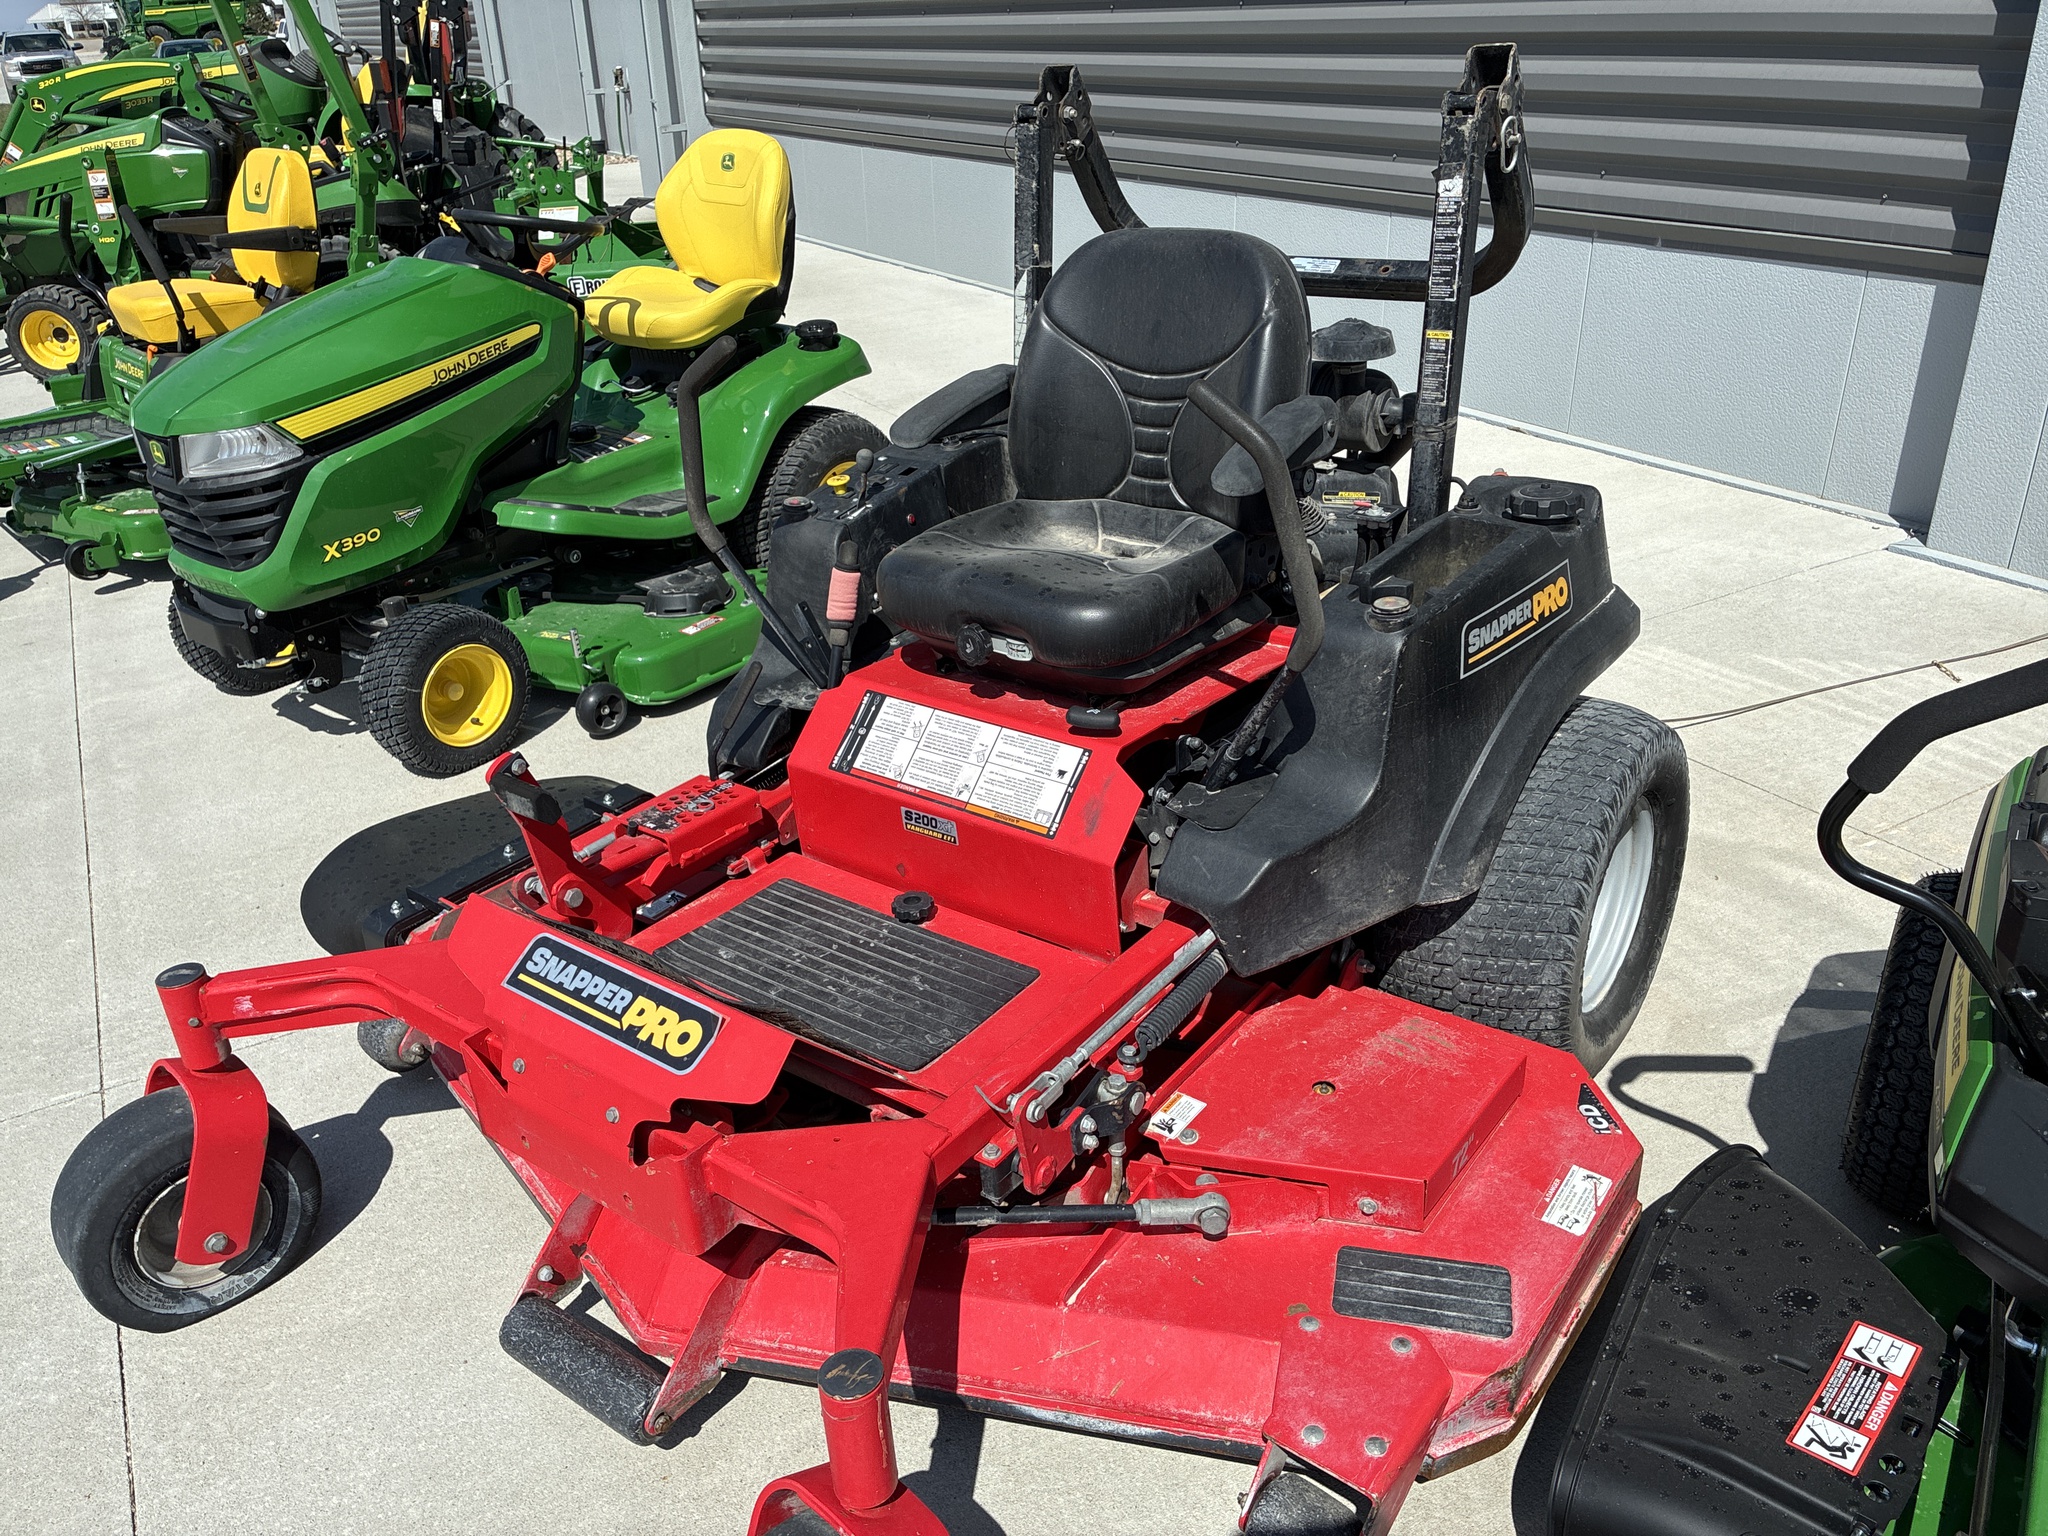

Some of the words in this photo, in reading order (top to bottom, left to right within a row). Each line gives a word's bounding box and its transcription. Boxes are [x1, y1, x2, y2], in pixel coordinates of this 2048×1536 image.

[80, 143, 104, 153] JOHN
[105, 138, 138, 148] DEERE
[115, 357, 128, 373] JOHN
[127, 362, 144, 380] DEERE
[431, 359, 466, 385] JOHN
[468, 338, 509, 366] DEERE
[322, 527, 381, 563] X390
[896, 782, 915, 792] DANGER
[906, 824, 942, 839] VANGUARD
[943, 834, 954, 843] EFI
[1951, 1001, 1963, 1076] DEERE
[1546, 1178, 1562, 1199] DANGER
[1864, 1391, 1895, 1432] DANGER
